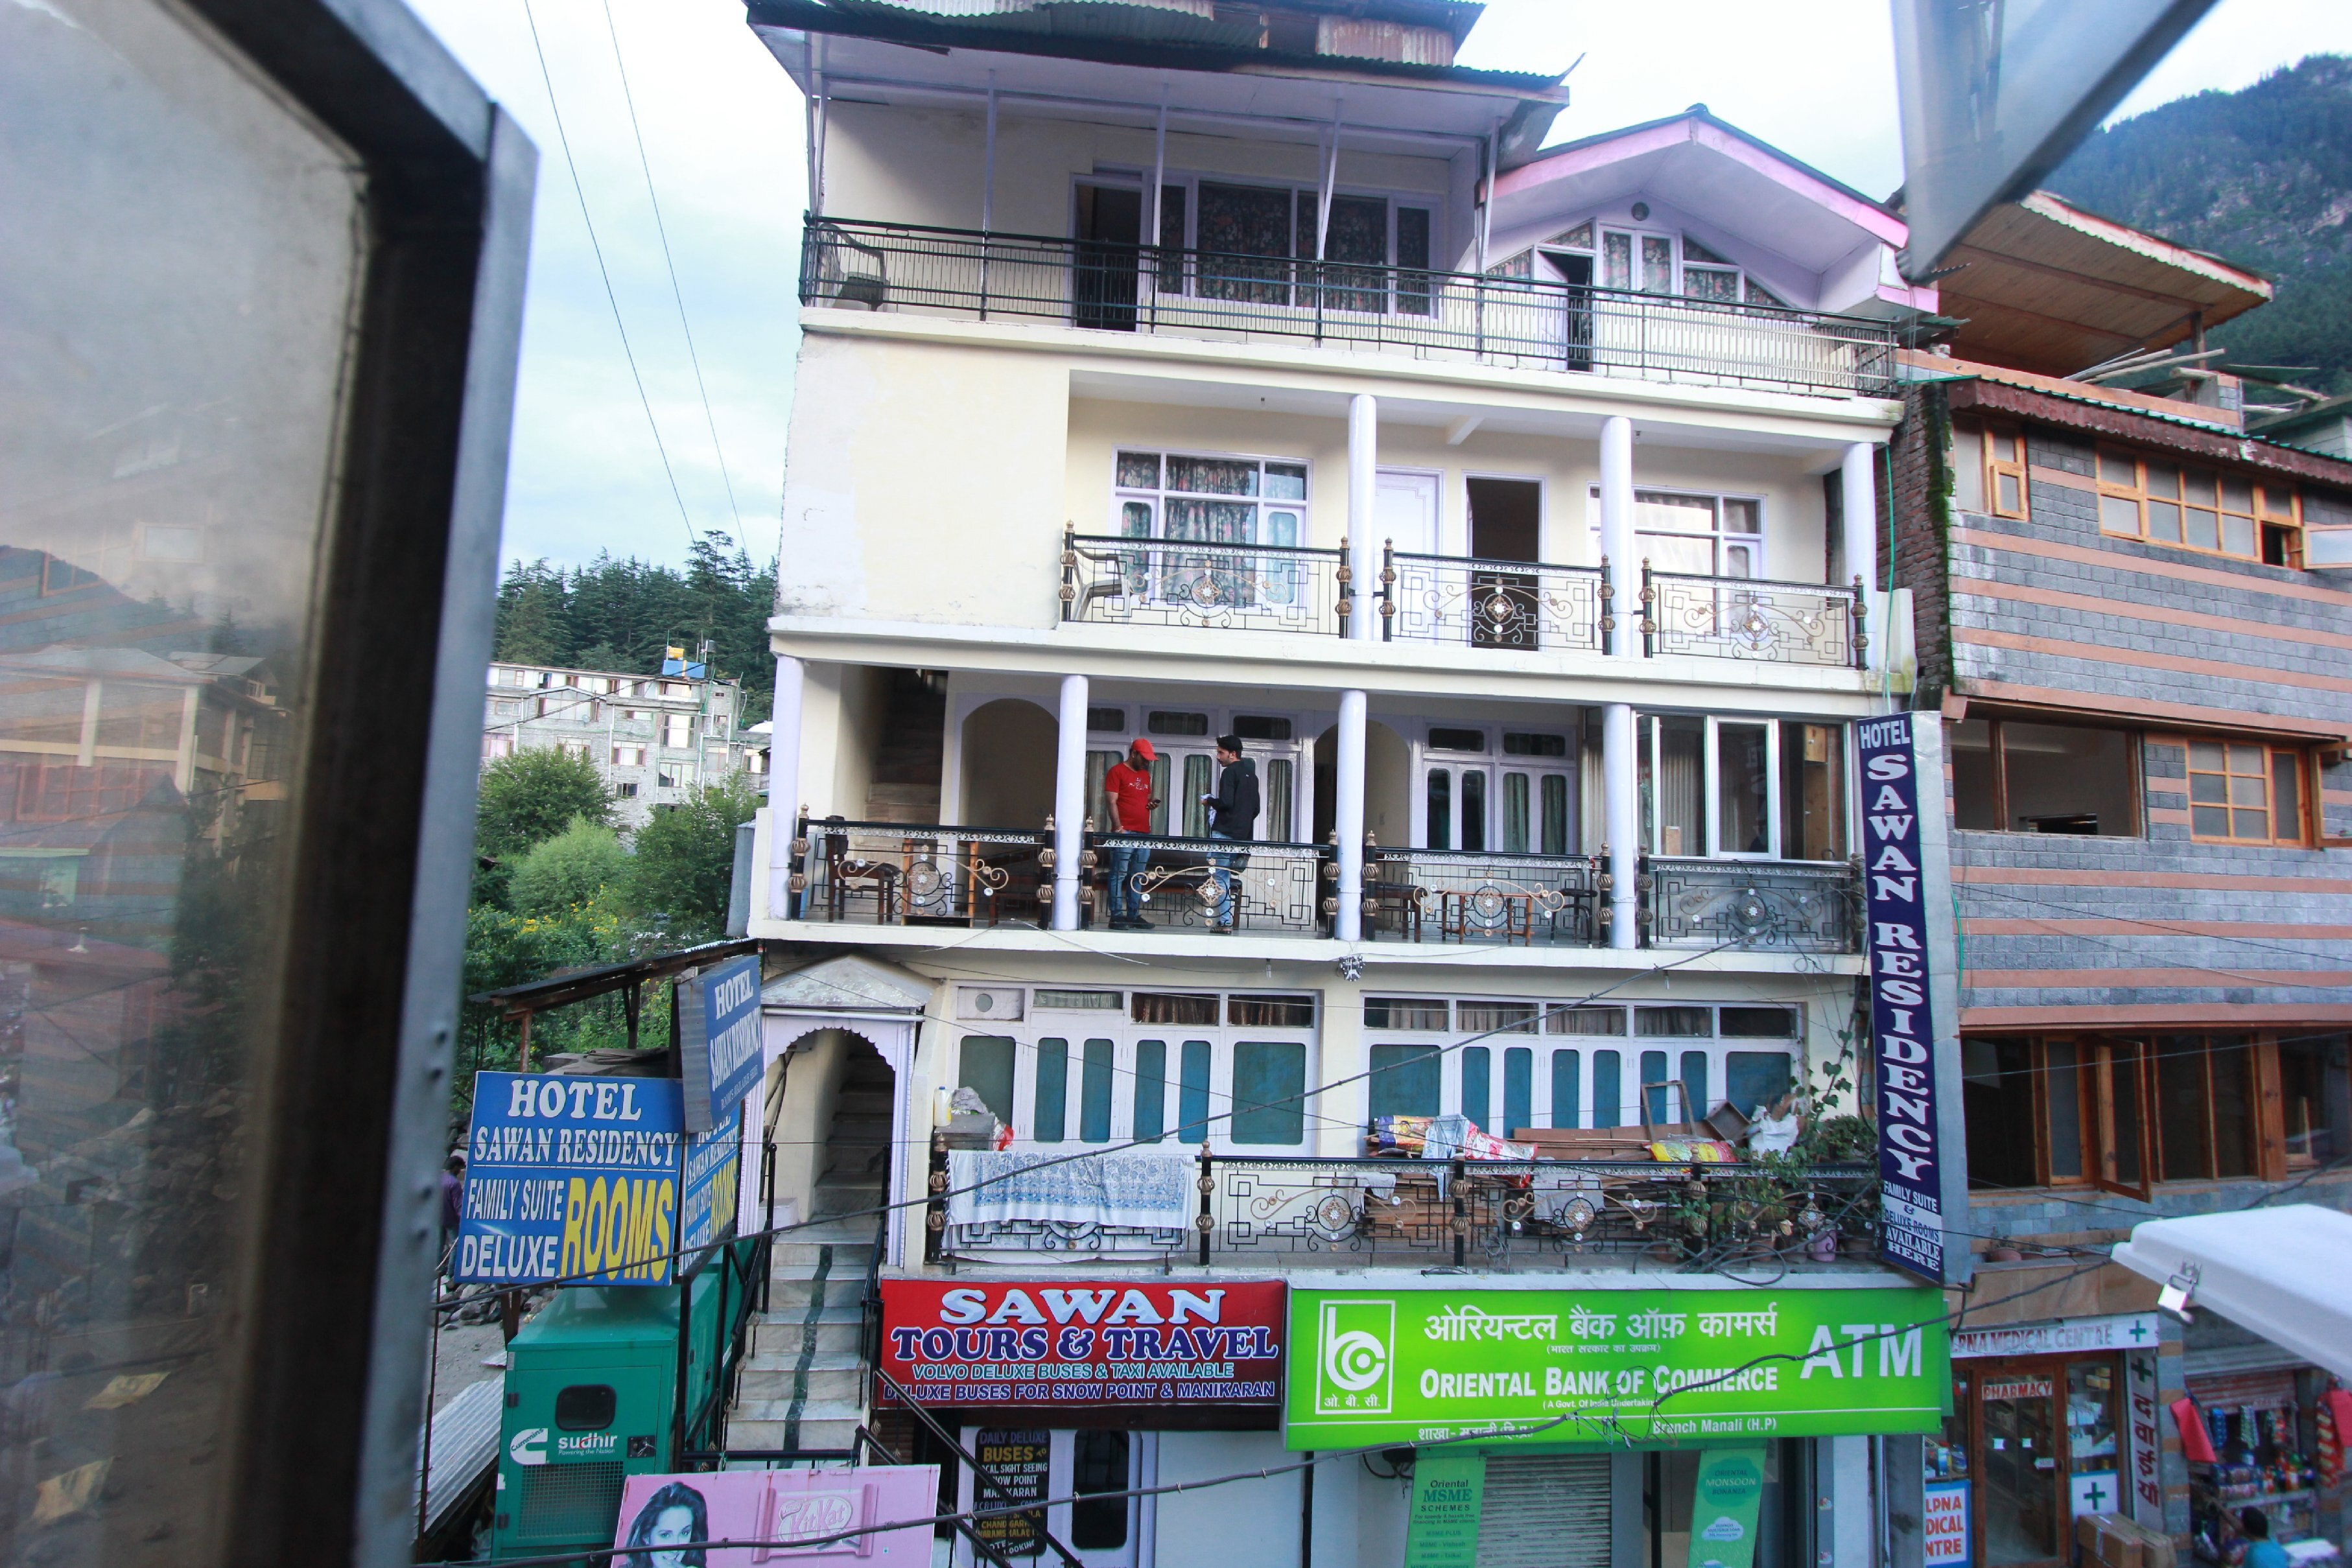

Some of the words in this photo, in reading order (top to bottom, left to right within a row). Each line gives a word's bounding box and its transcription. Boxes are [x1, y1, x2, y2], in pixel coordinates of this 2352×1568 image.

[1859, 720, 1911, 749] HOTEL
[1867, 754, 1917, 902] SAWAN
[715, 970, 753, 1020] HOTEL
[711, 1027, 733, 1092] SAWAN
[733, 1006, 761, 1072] RESIDENCY
[1874, 922, 1933, 1181] RESIDENCY
[508, 1079, 641, 1121] HOTEL
[475, 1126, 553, 1162] SAWAN
[557, 1129, 679, 1166] RESIDENCY
[688, 1150, 710, 1186] SAWAN
[709, 1125, 738, 1167] RESIDENCY
[466, 1178, 520, 1220] FAMILY
[521, 1178, 565, 1221] SUITE
[685, 1190, 701, 1230] FAMILY
[700, 1179, 712, 1216] SUITE
[711, 1155, 737, 1242] ROOMS
[1884, 1180, 1911, 1202] FAMILY
[1912, 1191, 1937, 1212] SUITE
[1904, 1204, 1914, 1215] &
[560, 1176, 673, 1281] ROOMS
[1885, 1208, 1912, 1230] DELUXE
[1913, 1220, 1939, 1243] ROOMS
[460, 1235, 558, 1278] DELUXE
[1886, 1225, 1940, 1261] AVAILABLE
[1887, 1240, 1939, 1272] HERE
[940, 1289, 1225, 1324] SAWAN
[1424, 1304, 1558, 1341] ओरियन्टल
[1568, 1304, 1617, 1340] बैंक
[1697, 1302, 1778, 1338] कामर्स
[891, 1326, 1048, 1361] TOURS
[1057, 1326, 1095, 1361] &
[1103, 1326, 1278, 1361] TRAVEL
[1578, 1344, 1608, 1353] सरकार
[1614, 1344, 1625, 1353] का
[1800, 1324, 1922, 1379] ATM
[1950, 1332, 1988, 1353] LPNA
[1990, 1329, 2052, 1352] MEDICAL
[2055, 1323, 2113, 1347] CENTRE
[913, 1364, 969, 1379] VOLVO
[971, 1364, 1035, 1379] DELUXE
[1037, 1363, 1092, 1379] BUSES
[1096, 1363, 1108, 1379] &
[1110, 1363, 1145, 1378] TAXI
[1147, 1363, 1234, 1378] AVAILABLE
[1420, 1368, 1536, 1398] ORIENTAL
[1545, 1367, 1612, 1396] BANK
[1616, 1370, 1645, 1394] OF
[1653, 1365, 1778, 1394] COMMERCE
[955, 1385, 1011, 1400] BUSES
[1015, 1384, 1049, 1399] FOR
[1052, 1383, 1102, 1399] SNOW
[1105, 1383, 1157, 1399] POINT
[1160, 1383, 1173, 1398] &
[1177, 1381, 1275, 1398] MANIKARAN
[1324, 1394, 1339, 1407] ओ.
[1345, 1394, 1359, 1407] बी.
[1364, 1393, 1380, 1407] सी.
[1556, 1400, 1576, 1409] Govt.
[1611, 1398, 1660, 1407] Undertakin
[1984, 1381, 2051, 1399] PHARMACY
[511, 1428, 545, 1451] Cummins
[558, 1432, 617, 1449] sudhir
[980, 1432, 1006, 1444] DAILY
[1011, 1431, 1047, 1444] DELUXE
[1652, 1420, 1697, 1434] Branch
[1701, 1418, 1743, 1433] Manali
[1747, 1418, 1777, 1431] (H.P)
[983, 1446, 1033, 1462] BUSES
[1037, 1448, 1047, 1458] TO
[1000, 1464, 1020, 1473] SIGHT
[1023, 1462, 1048, 1472] SEEING
[983, 1487, 1037, 1499] MAKARAN
[987, 1476, 1011, 1485] OW
[1013, 1475, 1039, 1485] POINT
[1431, 1479, 1468, 1488] Oriental
[1706, 1477, 1757, 1486] MONSOON
[1423, 1488, 1473, 1502] MSME
[1925, 1496, 1962, 1513] LPNA
[1925, 1515, 1964, 1536] DICAL
[1925, 1538, 1962, 1556] NTRE
